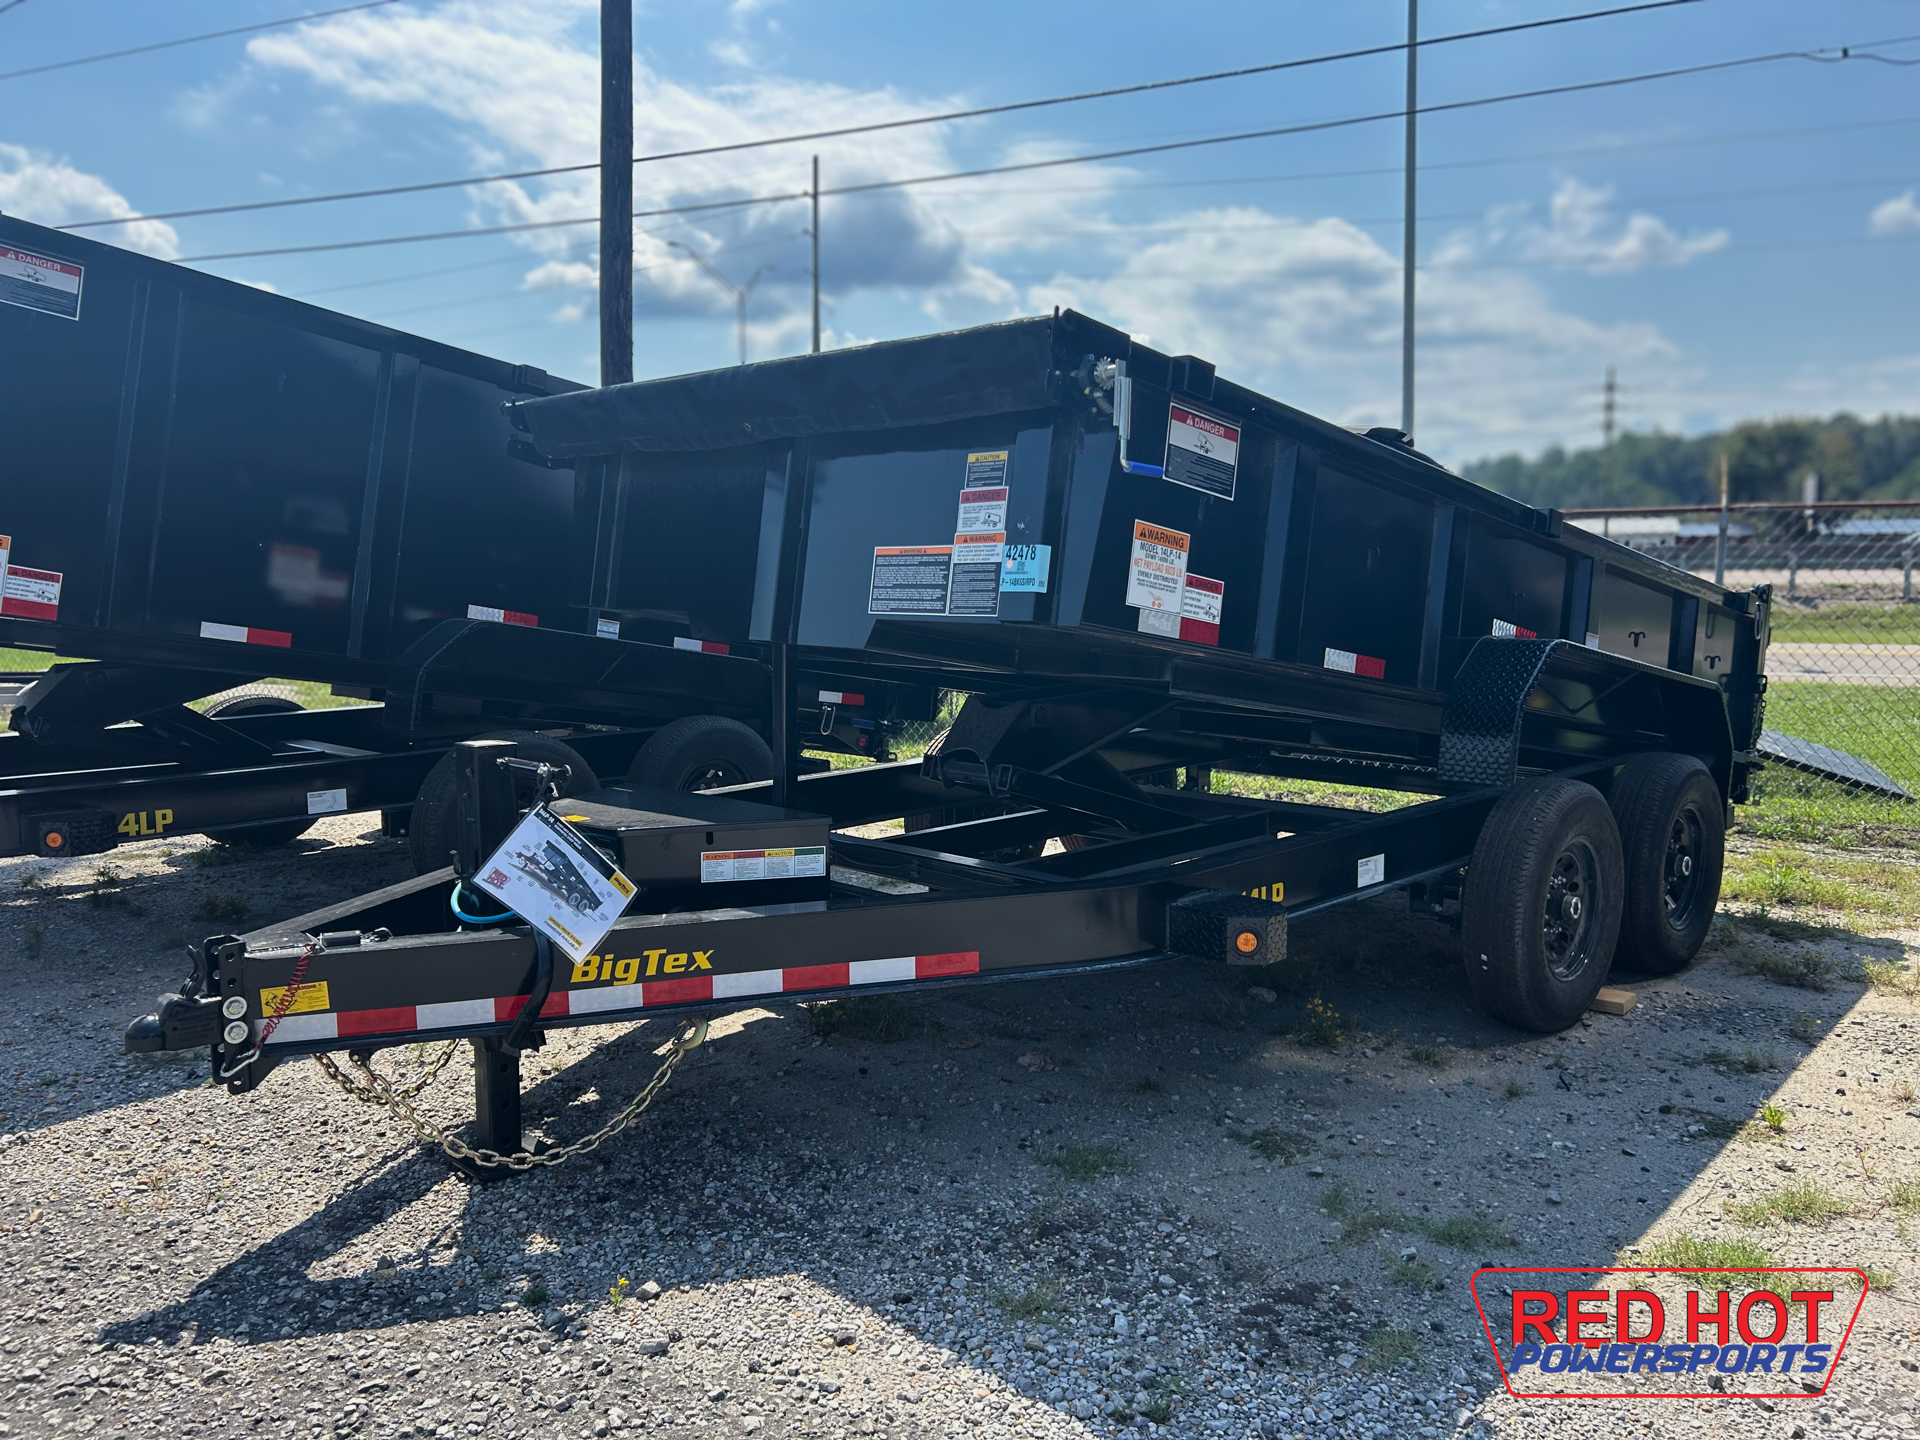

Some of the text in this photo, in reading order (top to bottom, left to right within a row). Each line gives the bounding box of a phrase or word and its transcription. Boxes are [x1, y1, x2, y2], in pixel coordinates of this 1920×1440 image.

[18, 254, 61, 271] DANGER
[1195, 418, 1225, 437] DANGER
[972, 492, 1002, 501] DANGER
[1148, 528, 1184, 548] WARNING
[1005, 545, 1037, 561] 42478
[1140, 541, 1181, 560] MODEL 14LP-14
[1134, 557, 1143, 567] NET
[1144, 560, 1164, 573] PAYLOAD
[22, 570, 54, 582] DANGER
[1138, 570, 1178, 584] EVENLY DISTRIBUTED
[1195, 579, 1218, 591] DANGER
[118, 809, 173, 836] 4LP
[487, 875, 505, 886] HOT
[495, 869, 508, 881] RED
[570, 949, 715, 986] BigTex
